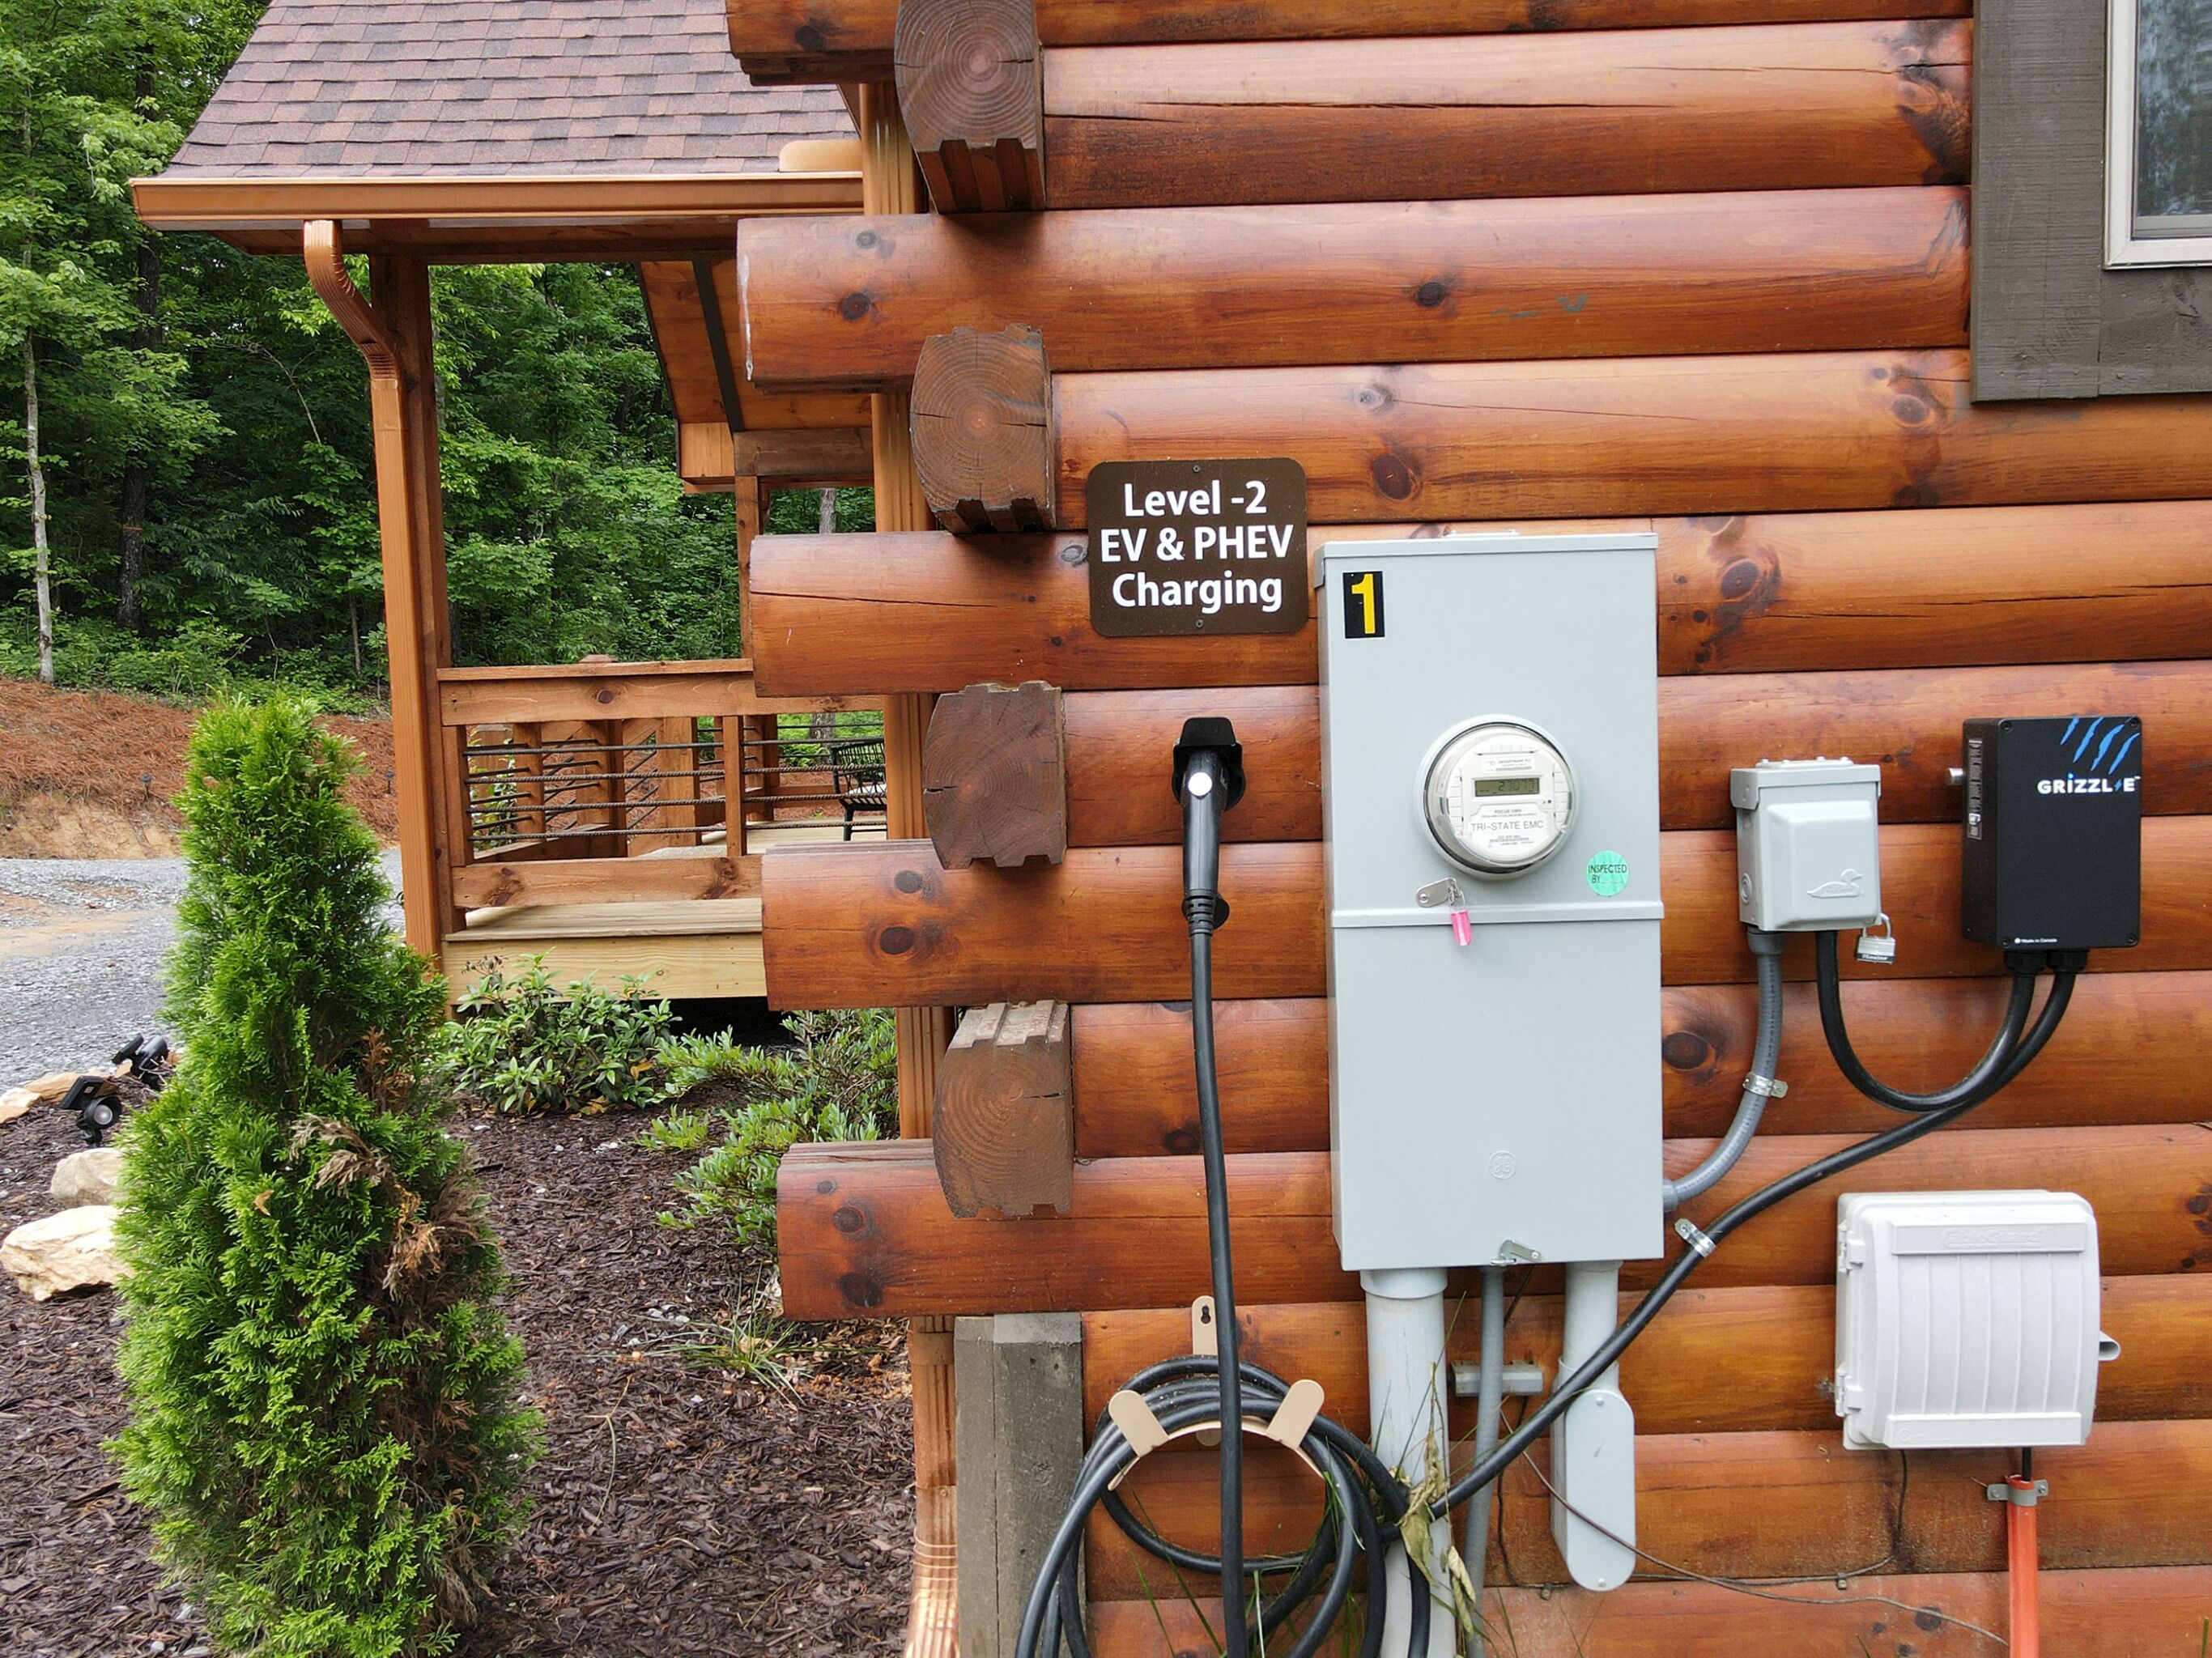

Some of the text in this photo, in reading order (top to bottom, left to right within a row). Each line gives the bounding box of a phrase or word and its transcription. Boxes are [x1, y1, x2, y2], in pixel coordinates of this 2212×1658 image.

[1124, 479, 1267, 517] Level -2
[1100, 524, 1294, 562] EV & PHEV
[1112, 570, 1283, 614] Charging
[1351, 573, 1376, 635] 1
[1471, 819, 1543, 831] TRI-STATE EMC
[1588, 864, 1627, 874] INSPECTED
[1591, 874, 1600, 883] BY
